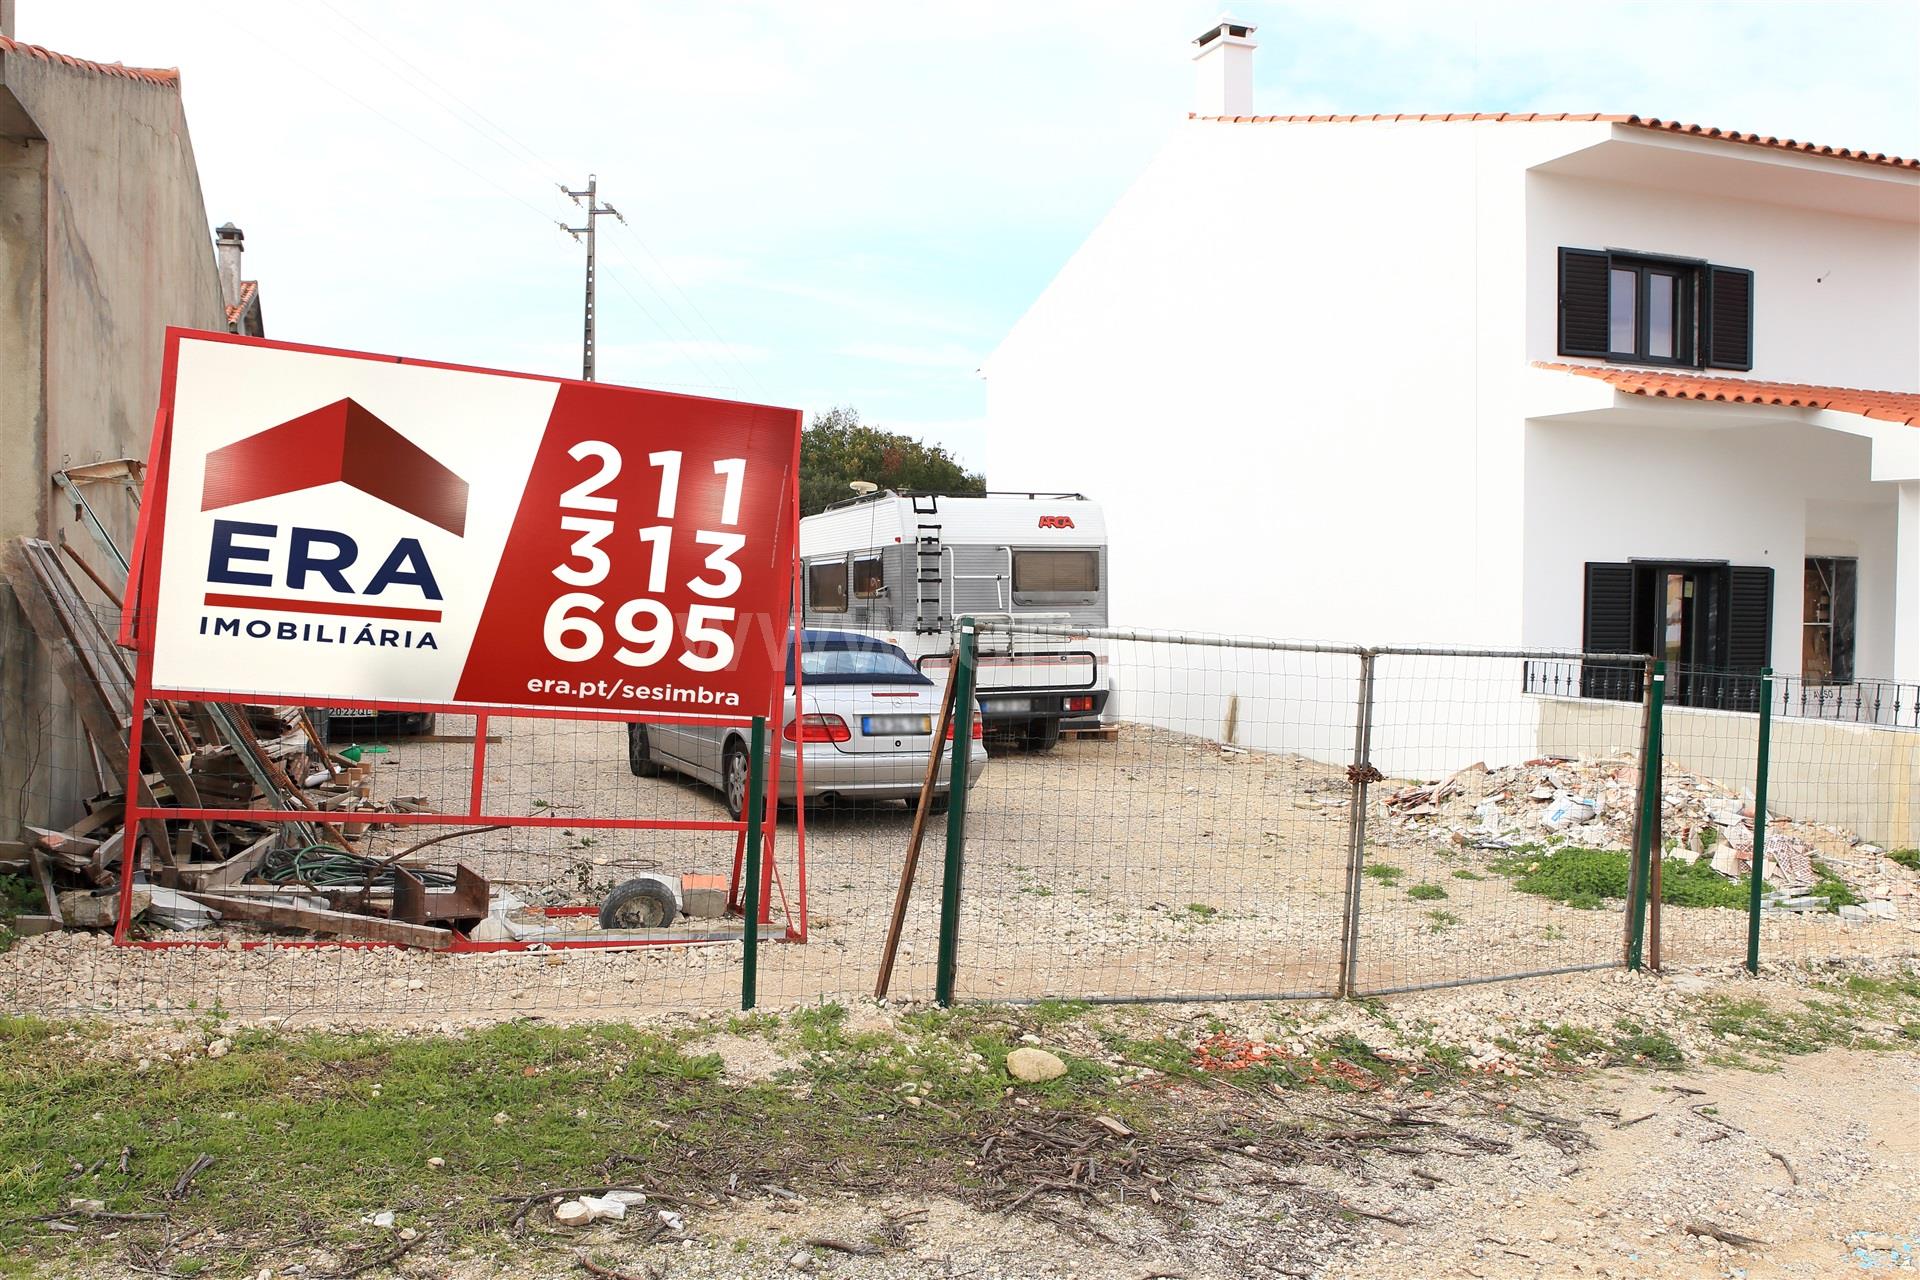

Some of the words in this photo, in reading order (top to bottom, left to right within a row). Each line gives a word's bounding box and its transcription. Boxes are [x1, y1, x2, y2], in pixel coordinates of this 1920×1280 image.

[559, 440, 747, 526] 211
[1038, 515, 1075, 529] ARCA
[206, 519, 443, 601] ERA
[551, 515, 747, 599] 313
[200, 617, 438, 649] IMOBILIÁRIA
[543, 592, 736, 673] 695
[527, 678, 740, 706] era.pt/sesimbra
